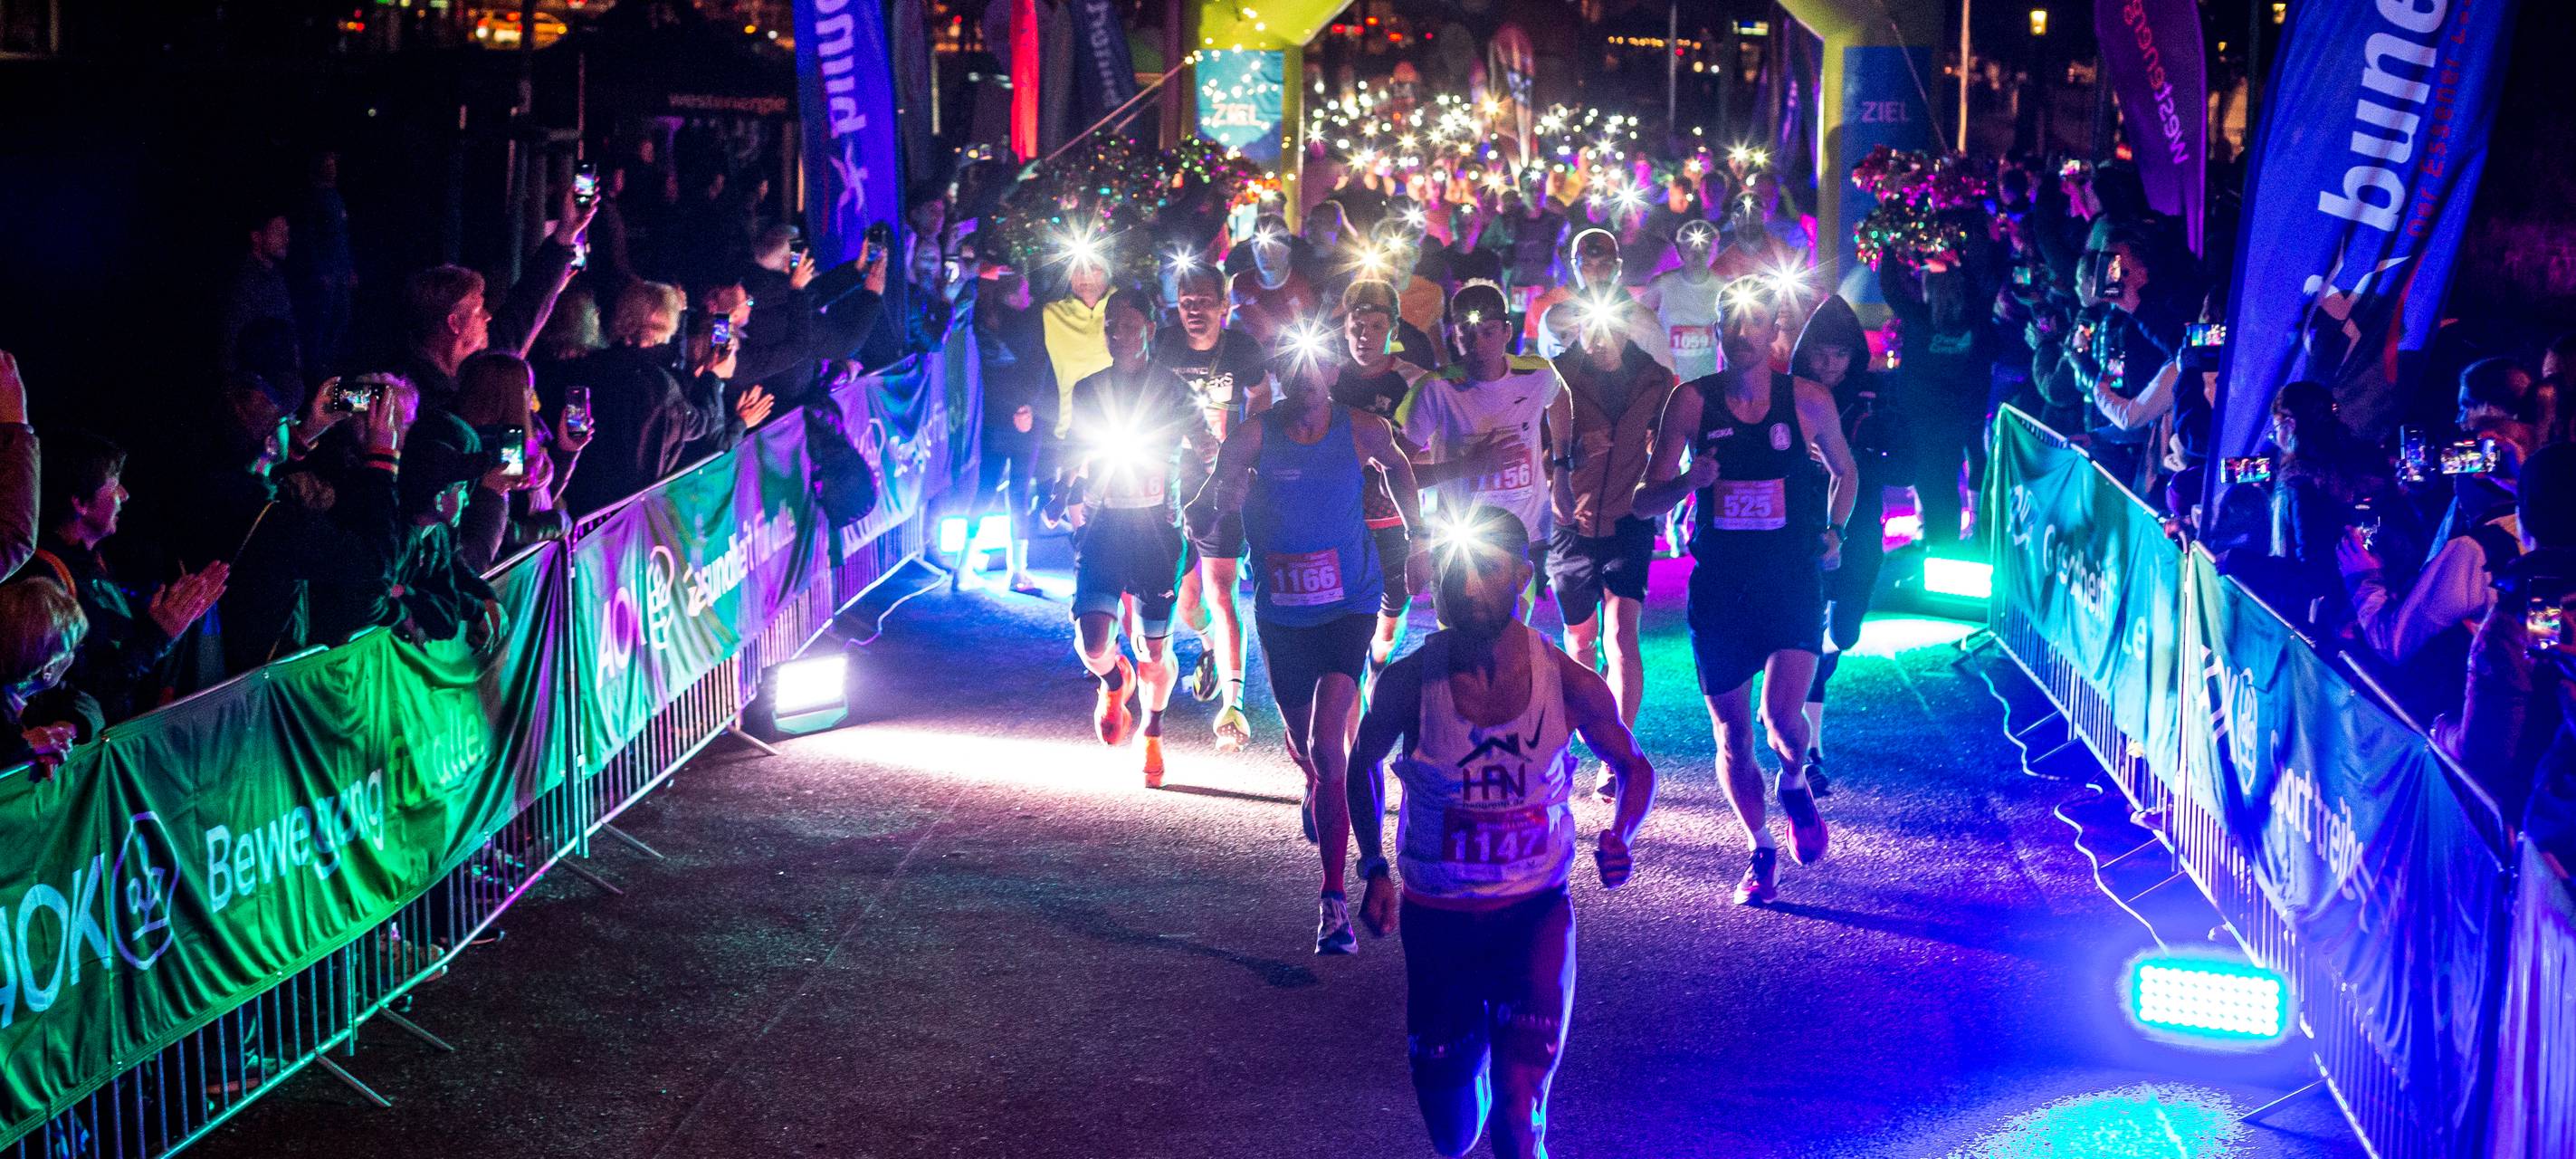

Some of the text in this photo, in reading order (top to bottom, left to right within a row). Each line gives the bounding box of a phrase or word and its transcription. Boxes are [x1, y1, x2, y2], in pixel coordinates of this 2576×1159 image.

[1212, 102, 1266, 126] ZIEL
[1862, 101, 1910, 123] ZIEL
[2419, 59, 2460, 177] Essener
[1724, 495, 1771, 517] 525
[1274, 565, 1336, 592] 1166
[1451, 828, 1541, 862] 1147
